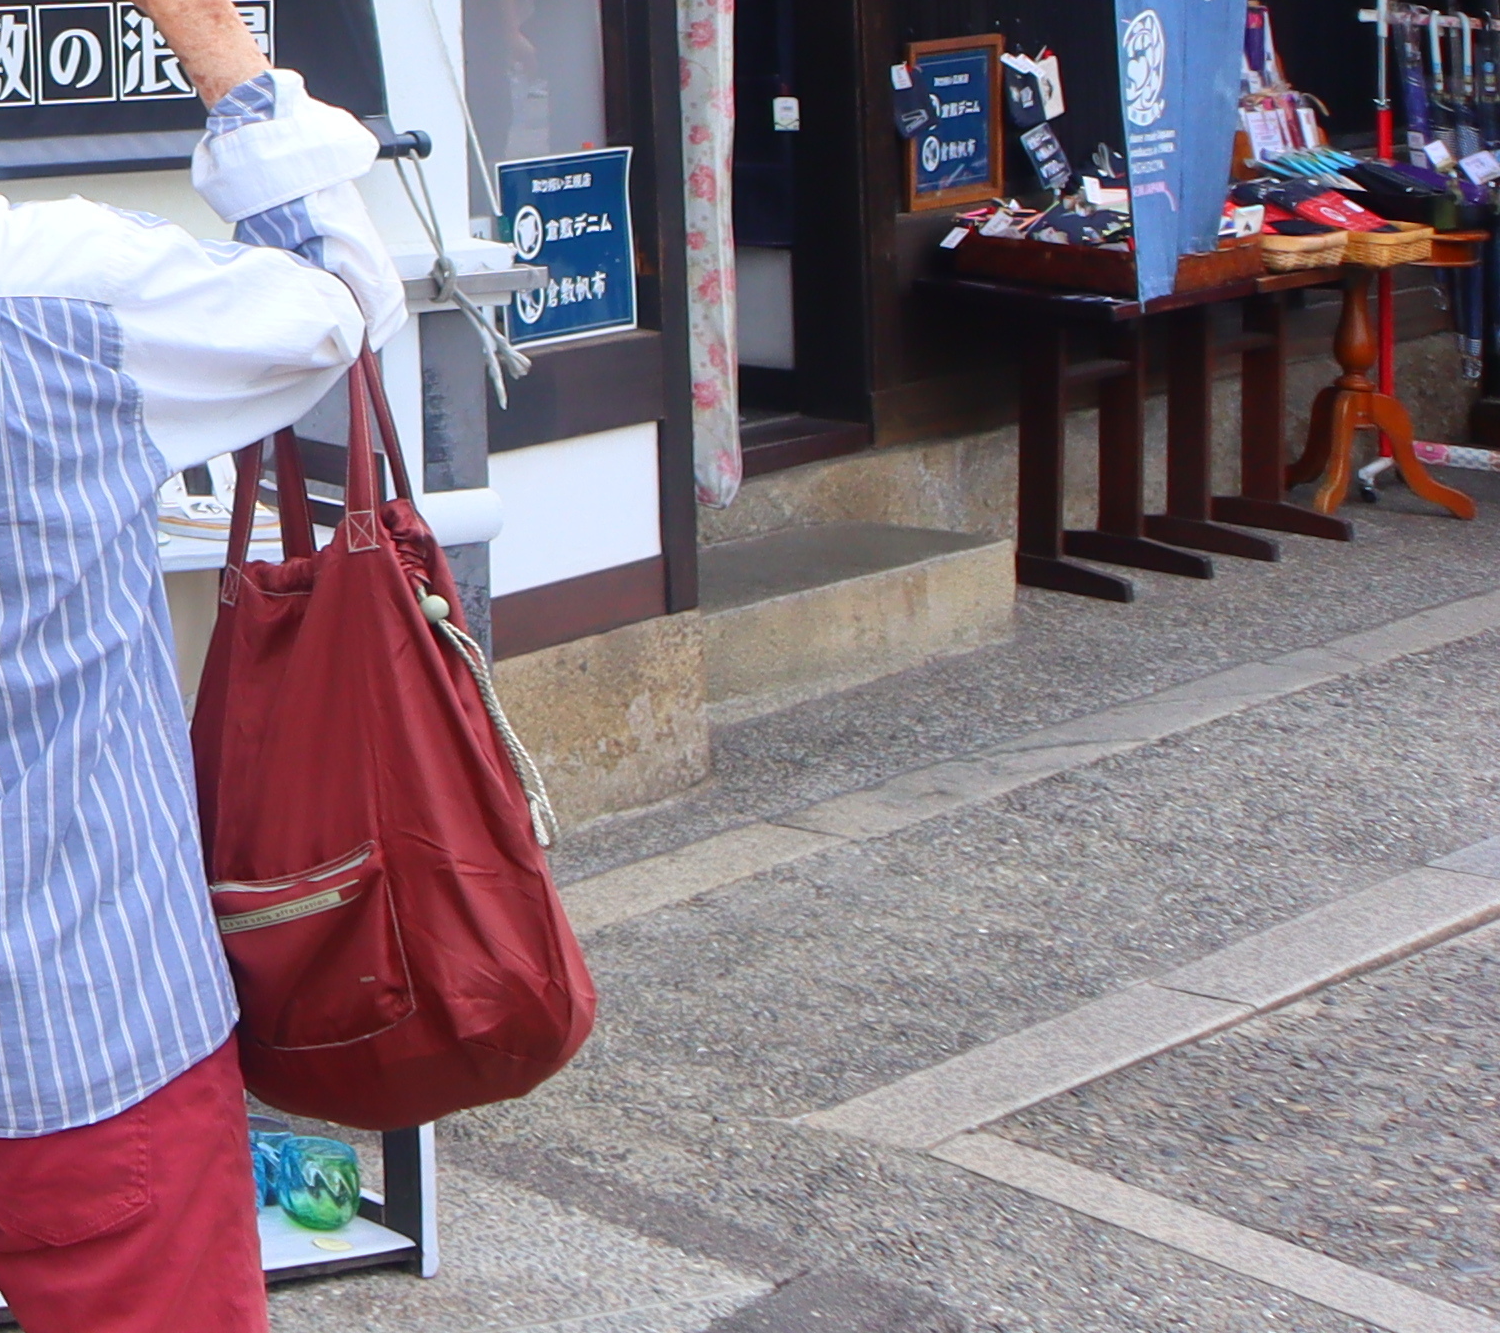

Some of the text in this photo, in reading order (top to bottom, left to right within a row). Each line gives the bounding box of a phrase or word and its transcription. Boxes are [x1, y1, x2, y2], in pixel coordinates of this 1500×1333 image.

[545, 212, 612, 241] 倉敷デニム
[546, 271, 607, 308] 倉敷帆布
